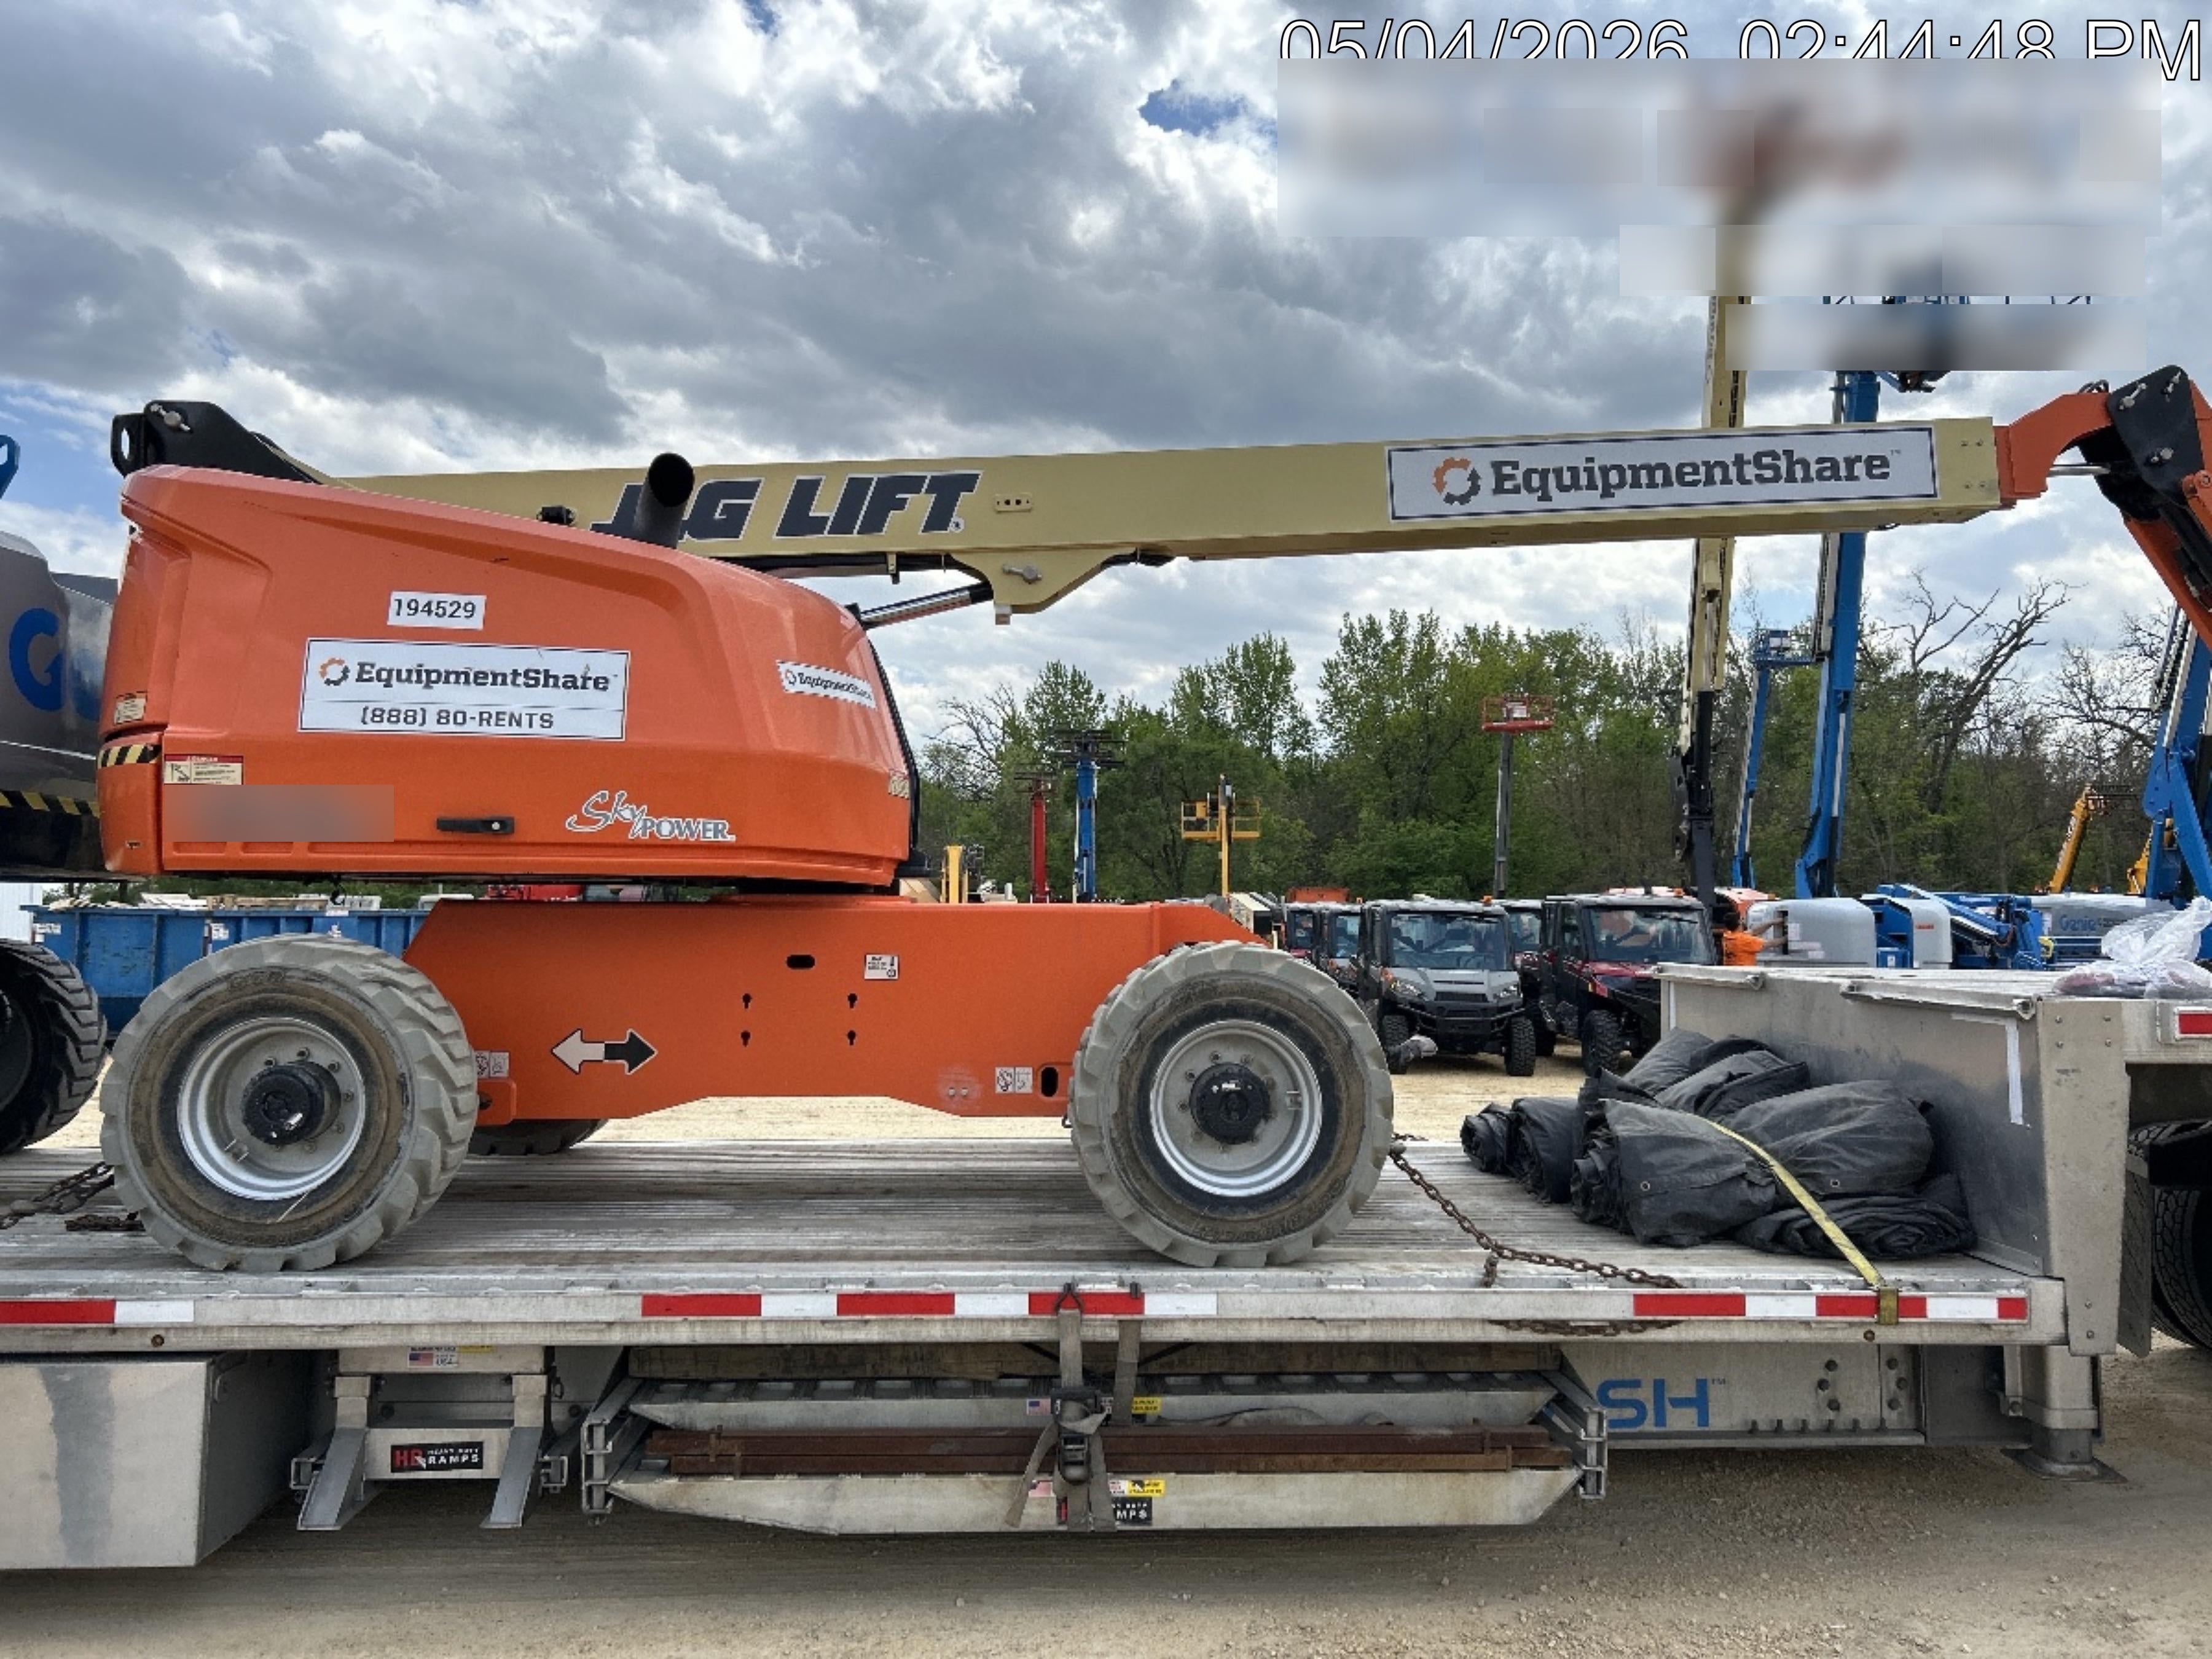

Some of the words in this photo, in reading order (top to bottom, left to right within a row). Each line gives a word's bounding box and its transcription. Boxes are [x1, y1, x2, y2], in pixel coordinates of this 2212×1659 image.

[1490, 449, 1890, 502] EquipmentShare
[589, 479, 765, 541] JG
[773, 471, 984, 539] LIFT
[394, 598, 476, 620] 194529
[355, 661, 610, 692] EquipmentShare
[361, 706, 426, 726] (888)
[436, 709, 554, 729] 80-RENTS
[428, 1453, 479, 1464] RAMPS
